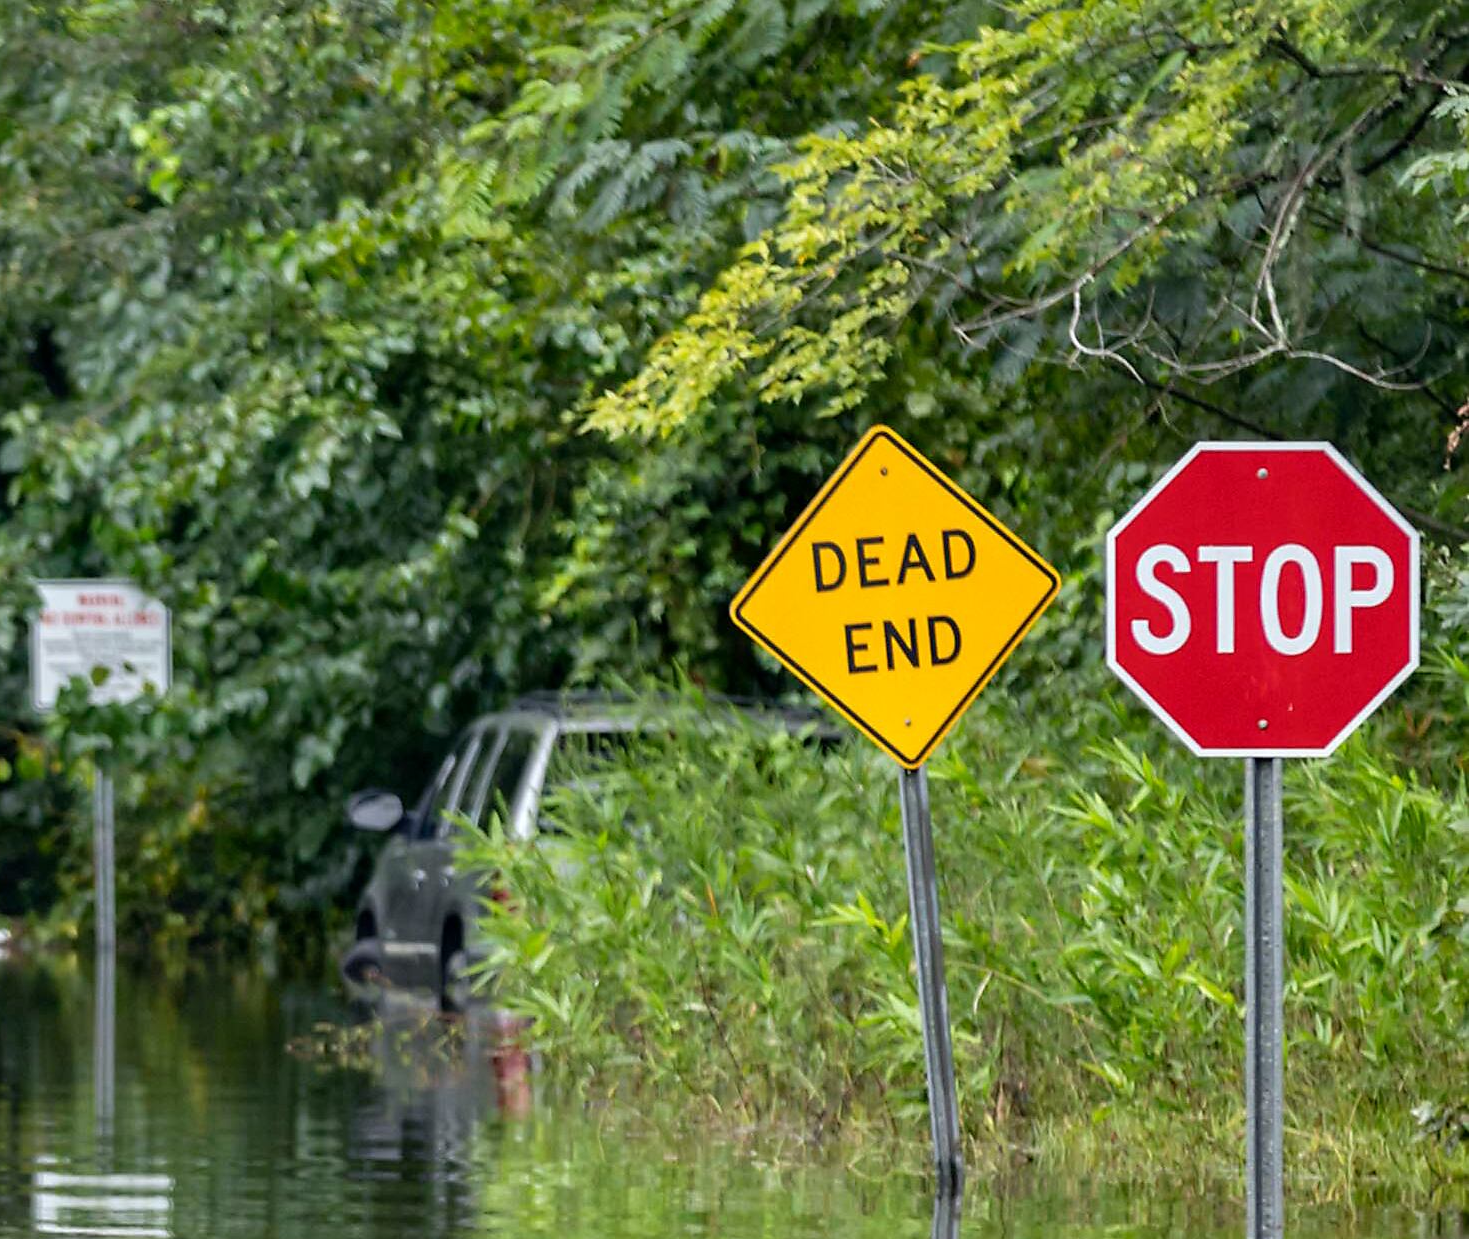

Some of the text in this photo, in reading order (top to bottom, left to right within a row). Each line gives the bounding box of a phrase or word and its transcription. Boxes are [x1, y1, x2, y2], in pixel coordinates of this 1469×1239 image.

[811, 528, 977, 594] DEAD
[1130, 543, 1395, 656] STOP
[844, 615, 962, 675] END
